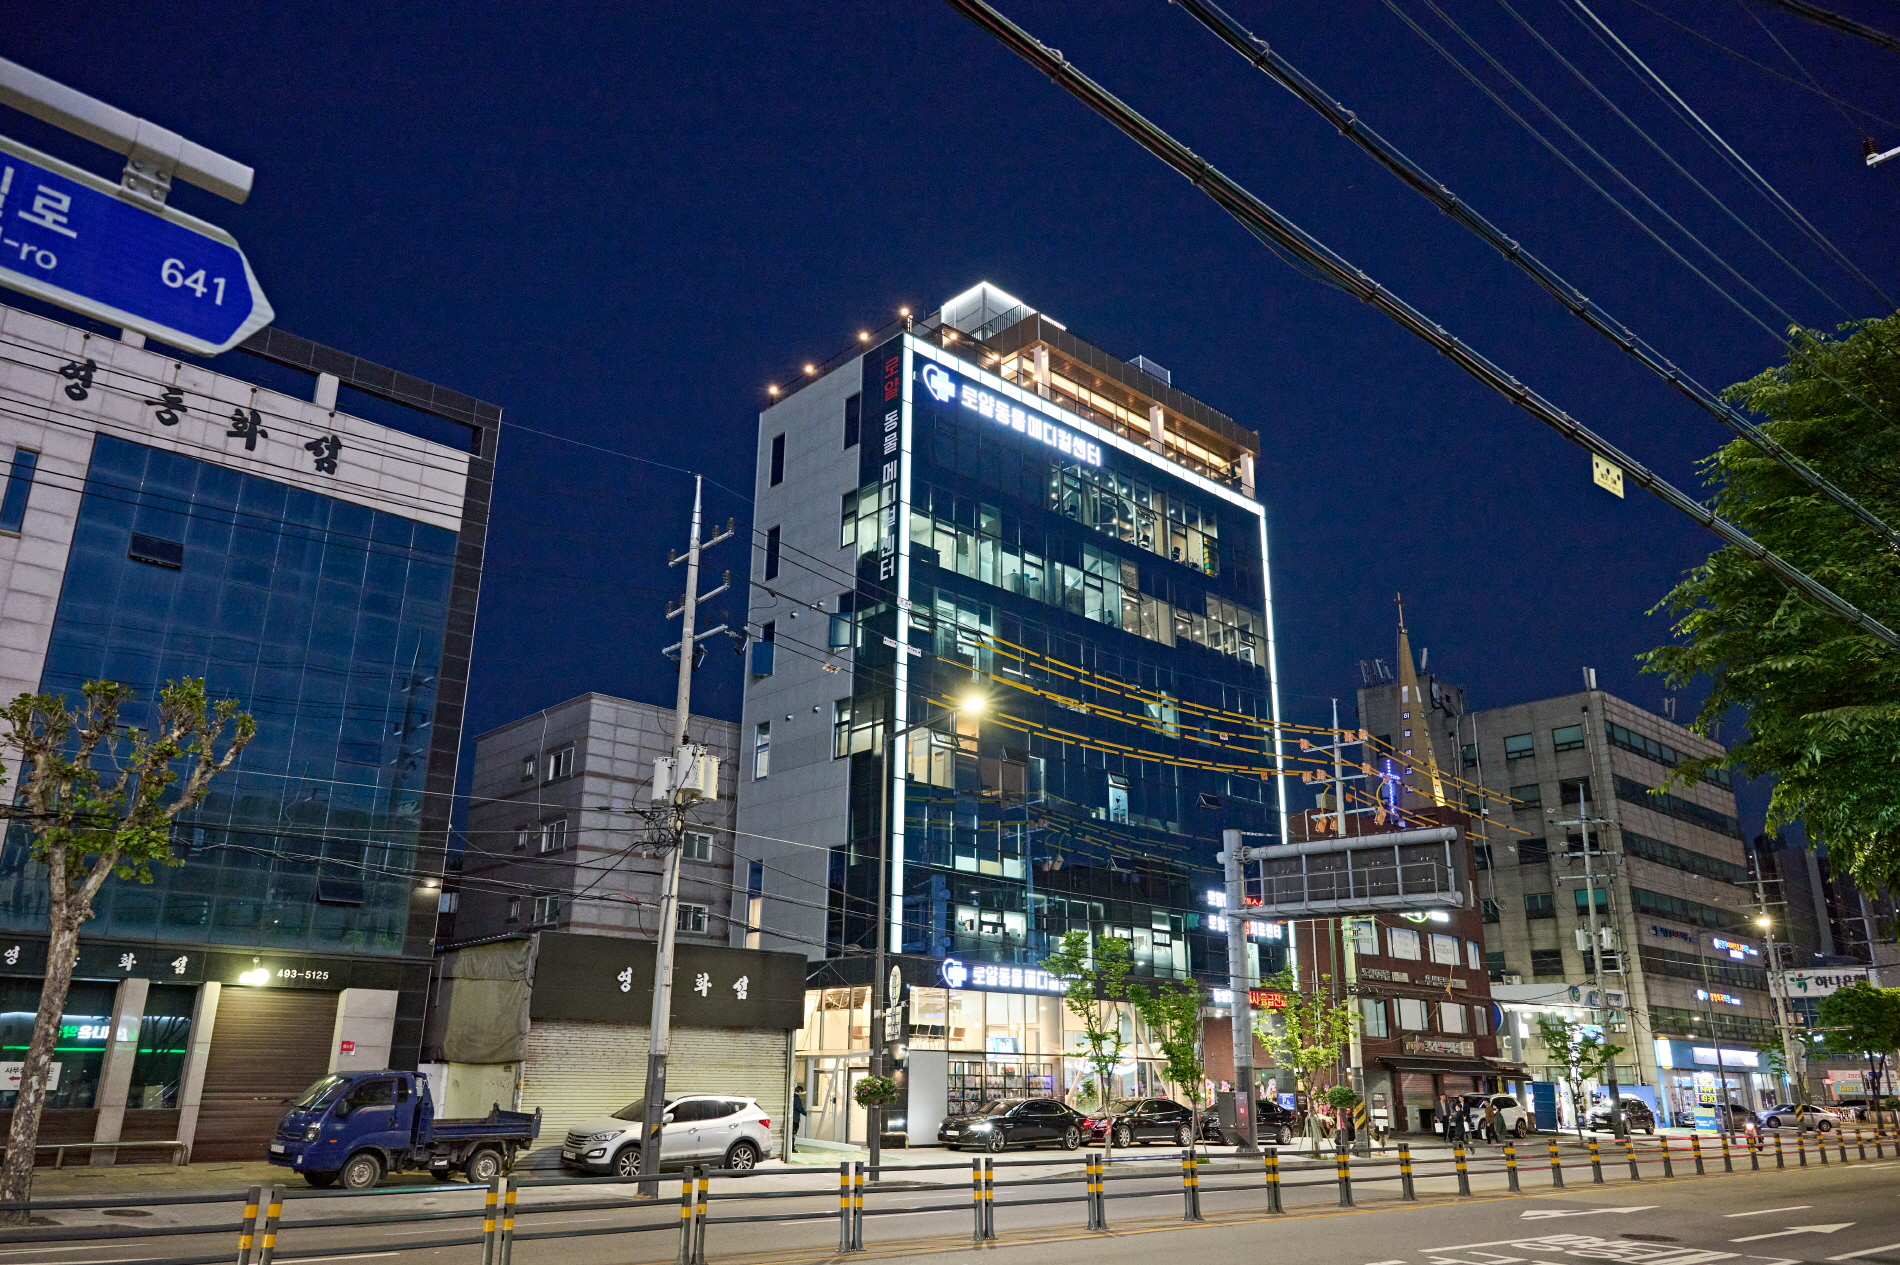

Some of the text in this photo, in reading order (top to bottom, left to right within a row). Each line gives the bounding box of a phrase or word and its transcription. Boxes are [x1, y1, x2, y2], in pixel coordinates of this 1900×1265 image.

[161, 258, 226, 306] 641
[884, 409, 898, 455] 동물
[962, 384, 1101, 467] 로얄동물메디컬센터
[880, 534, 895, 581] 센터
[4, 945, 189, 975] 영화섬
[277, 968, 329, 980] 493-5125
[617, 966, 749, 1000] 영화섬
